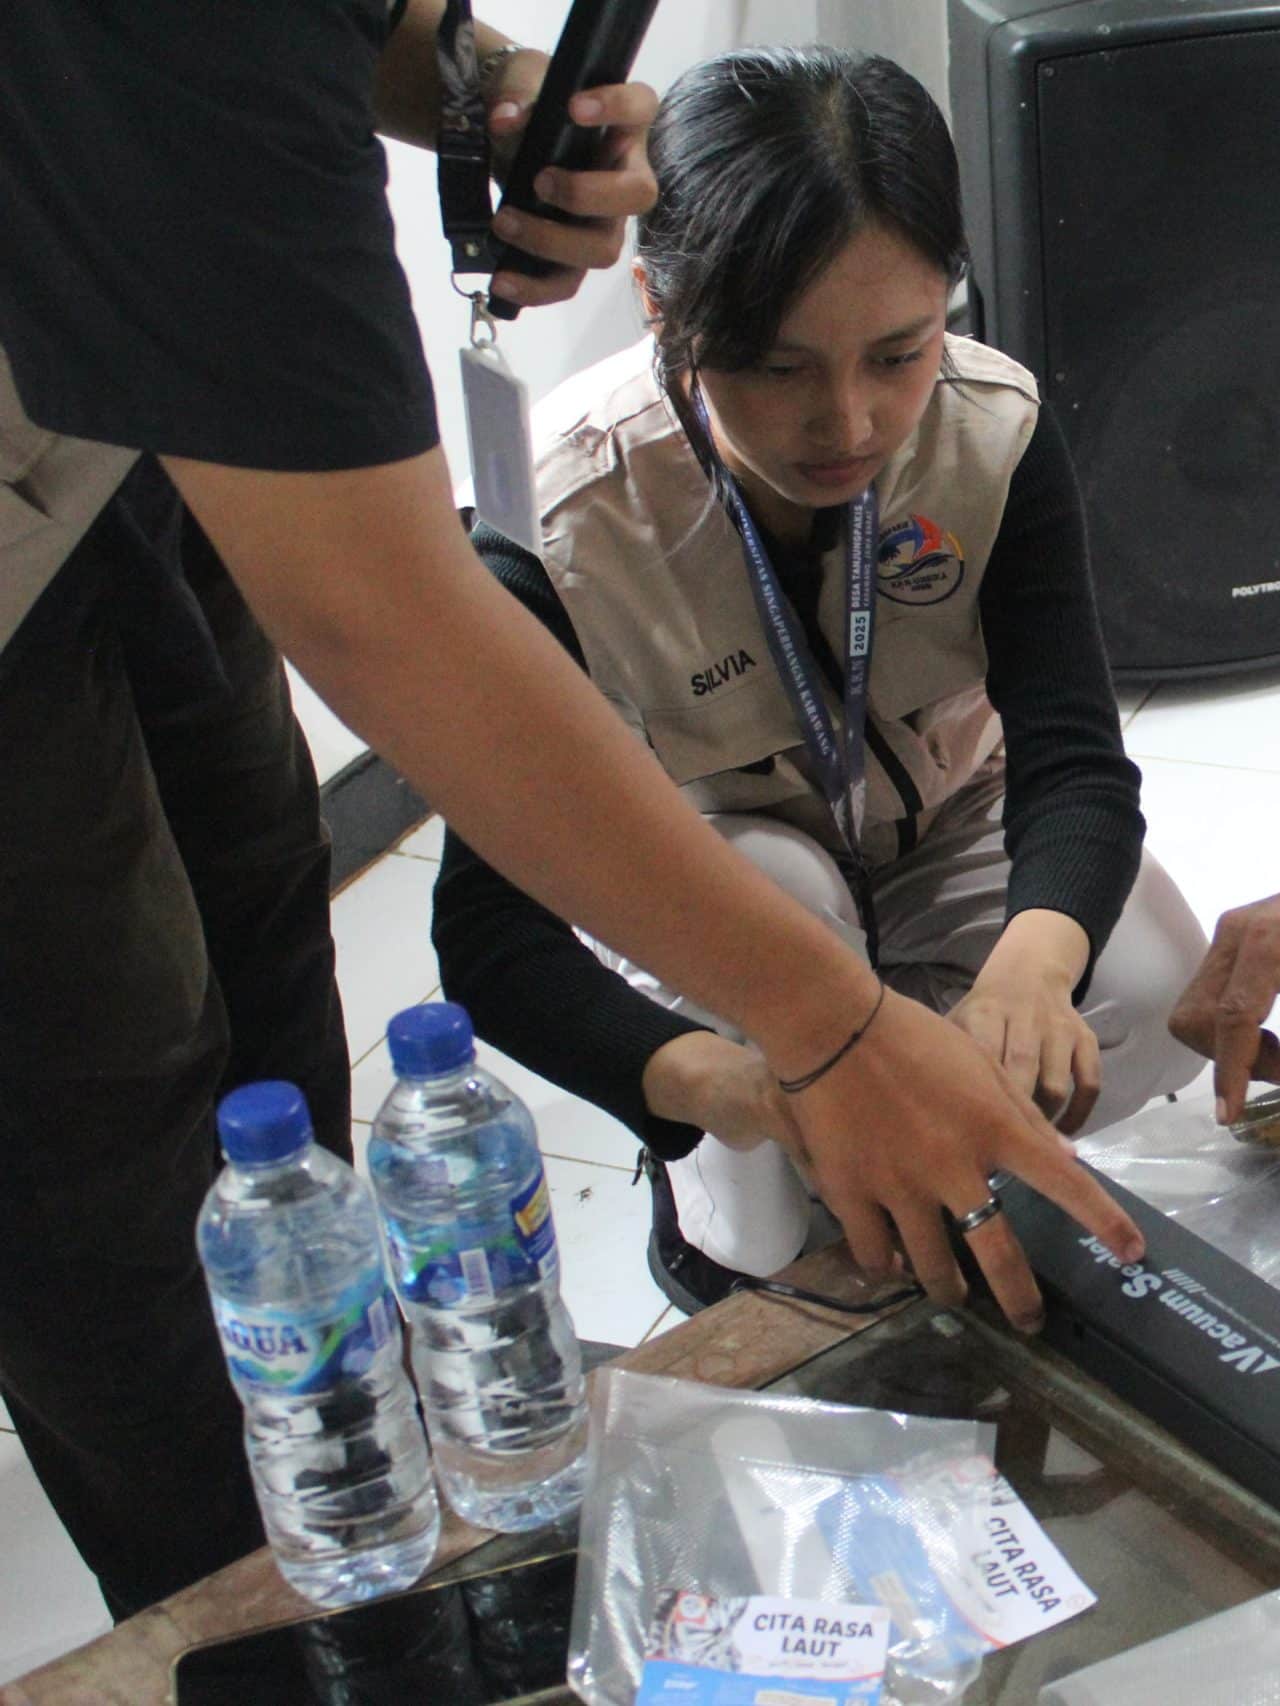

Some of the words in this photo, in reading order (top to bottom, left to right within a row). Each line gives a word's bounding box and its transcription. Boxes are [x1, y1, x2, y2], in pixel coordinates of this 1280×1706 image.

[851, 504, 864, 581] TANJUNGPAKIS
[851, 583, 861, 608] DESA
[854, 615, 866, 651] 2025
[691, 649, 757, 696] SILVIA
[799, 689, 831, 756] KARAWANG
[1157, 1288, 1261, 1374] Vacuum
[989, 1516, 1026, 1562] CITA
[1013, 1561, 1062, 1613] RASA
[753, 1613, 805, 1633] CITA
[813, 1618, 874, 1638] RASA
[781, 1636, 842, 1657] LAUT
